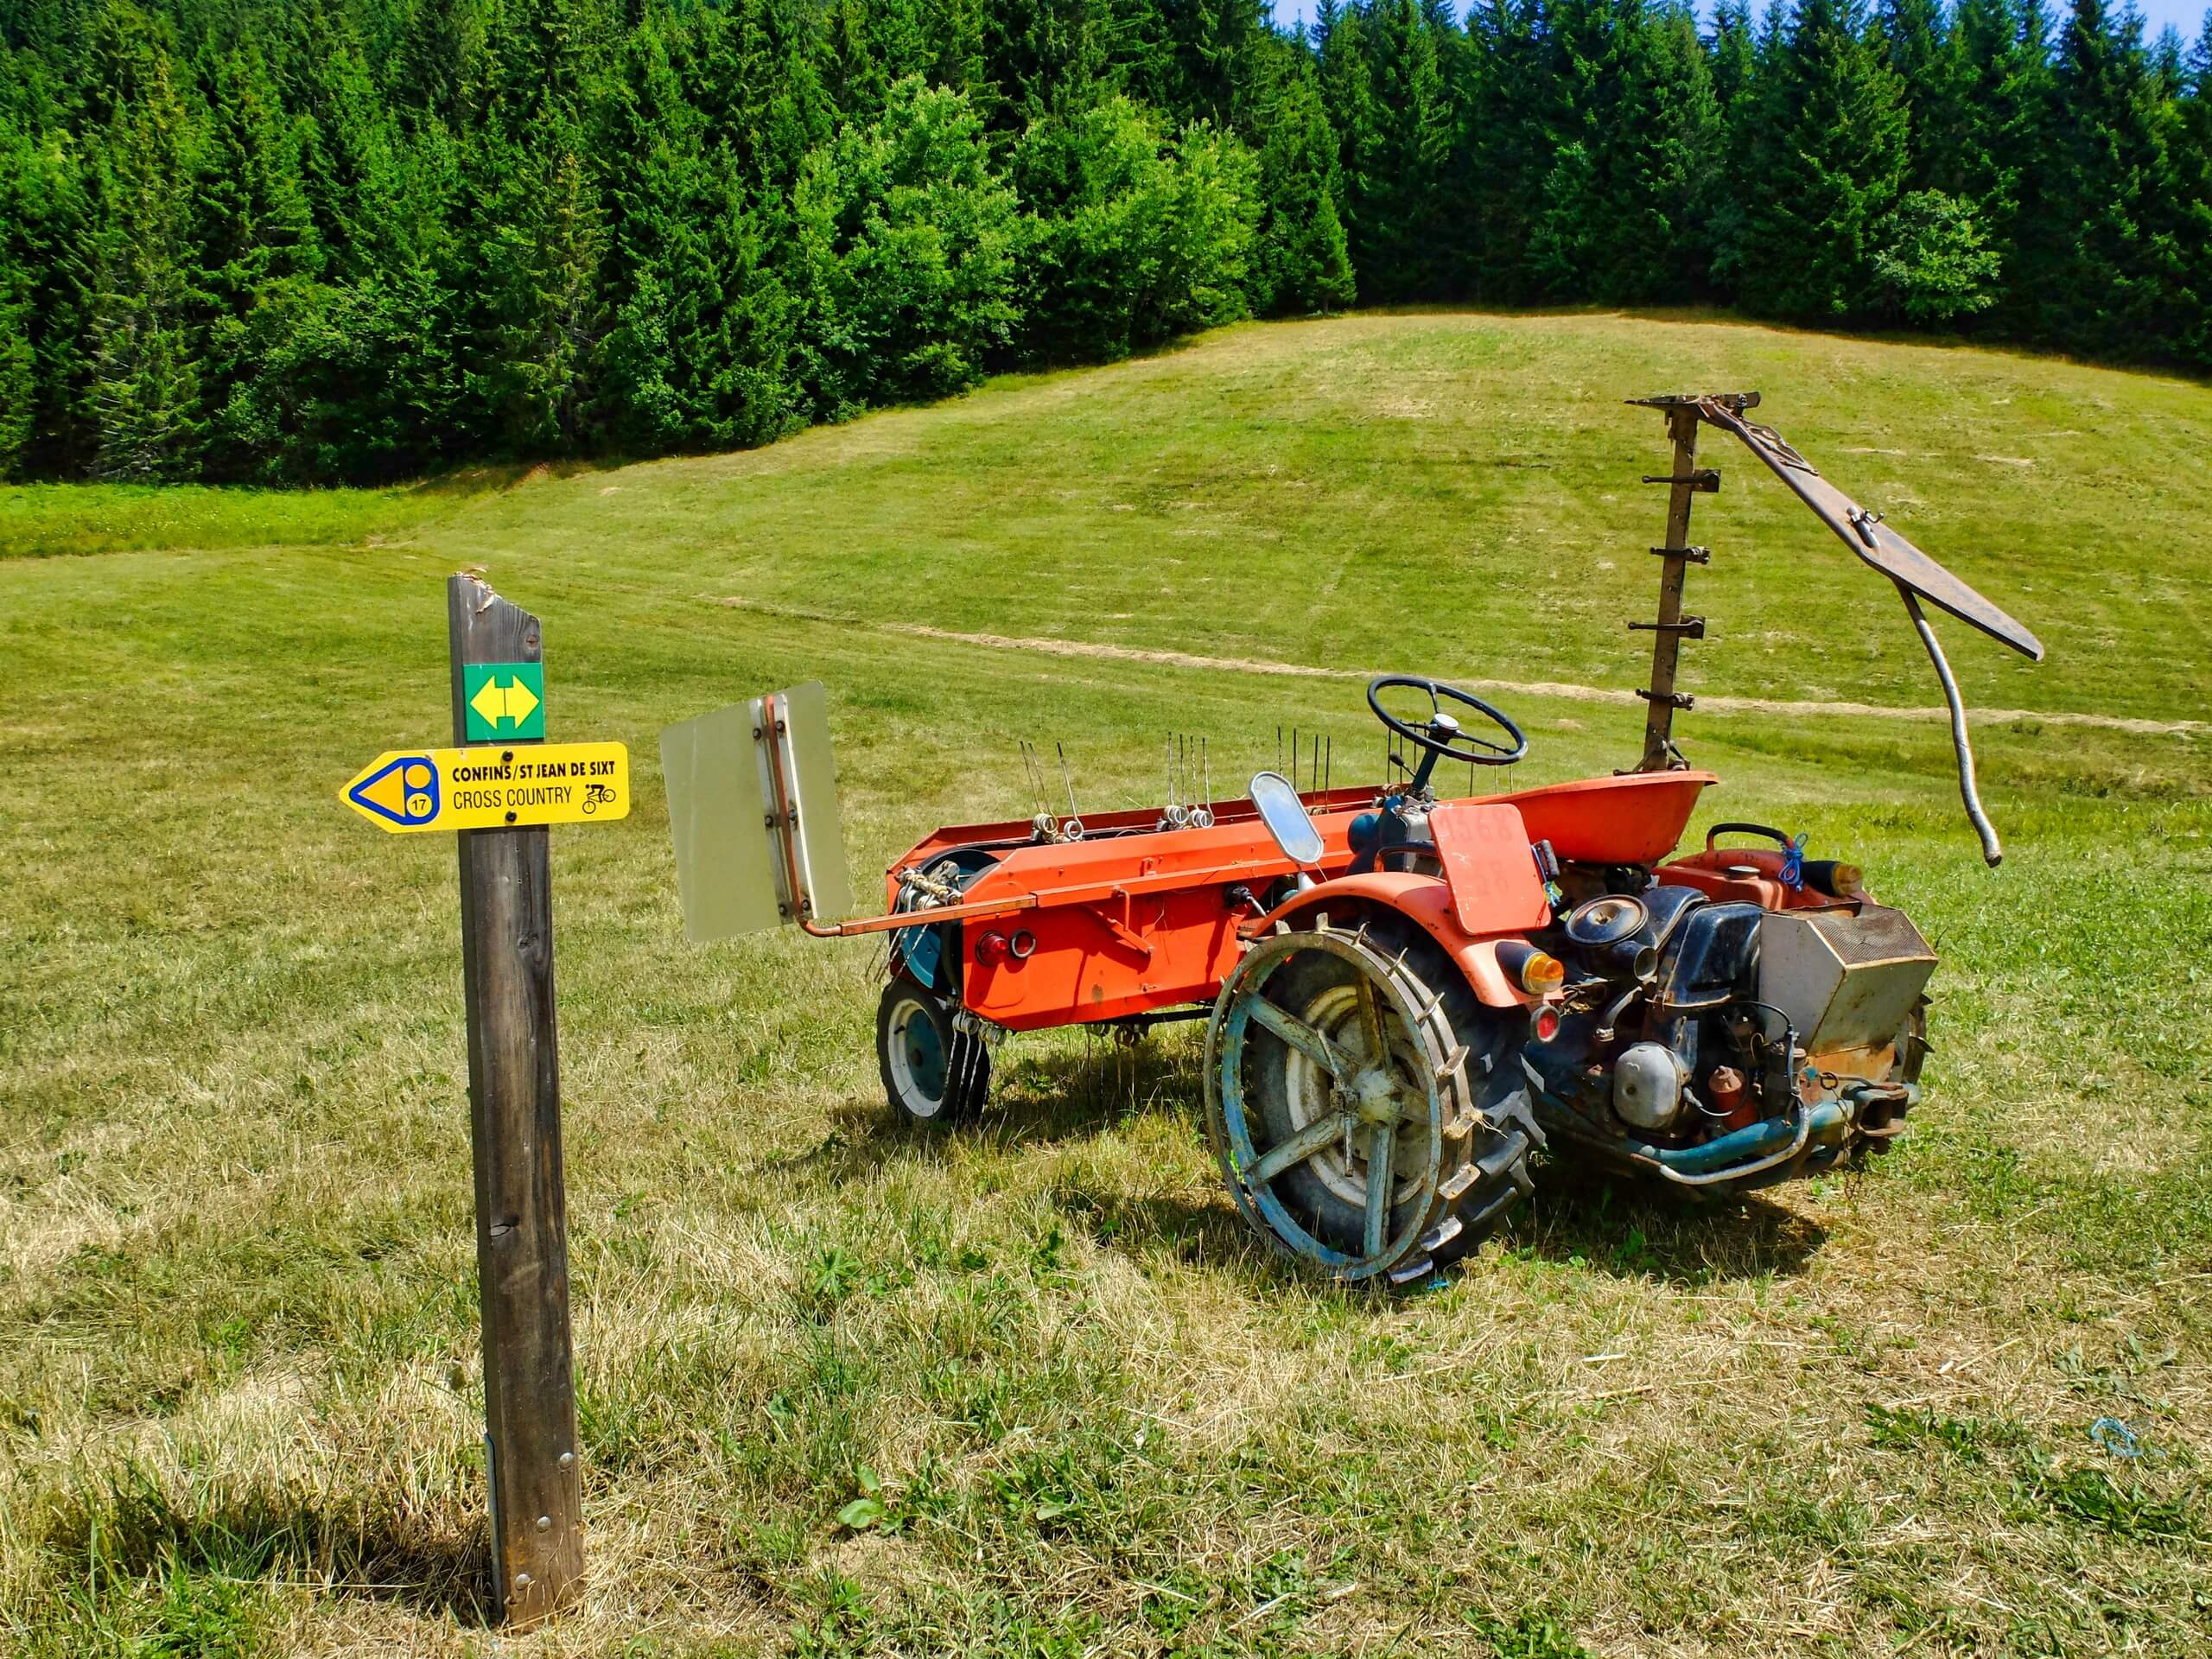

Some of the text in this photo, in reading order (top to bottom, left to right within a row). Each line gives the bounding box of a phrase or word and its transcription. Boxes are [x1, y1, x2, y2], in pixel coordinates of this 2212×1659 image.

[536, 763, 567, 779] JEAN
[570, 762, 587, 777] DE
[589, 760, 615, 776] SIXT
[411, 799, 427, 811] 17
[453, 786, 573, 810] CROSS COUNTRY
